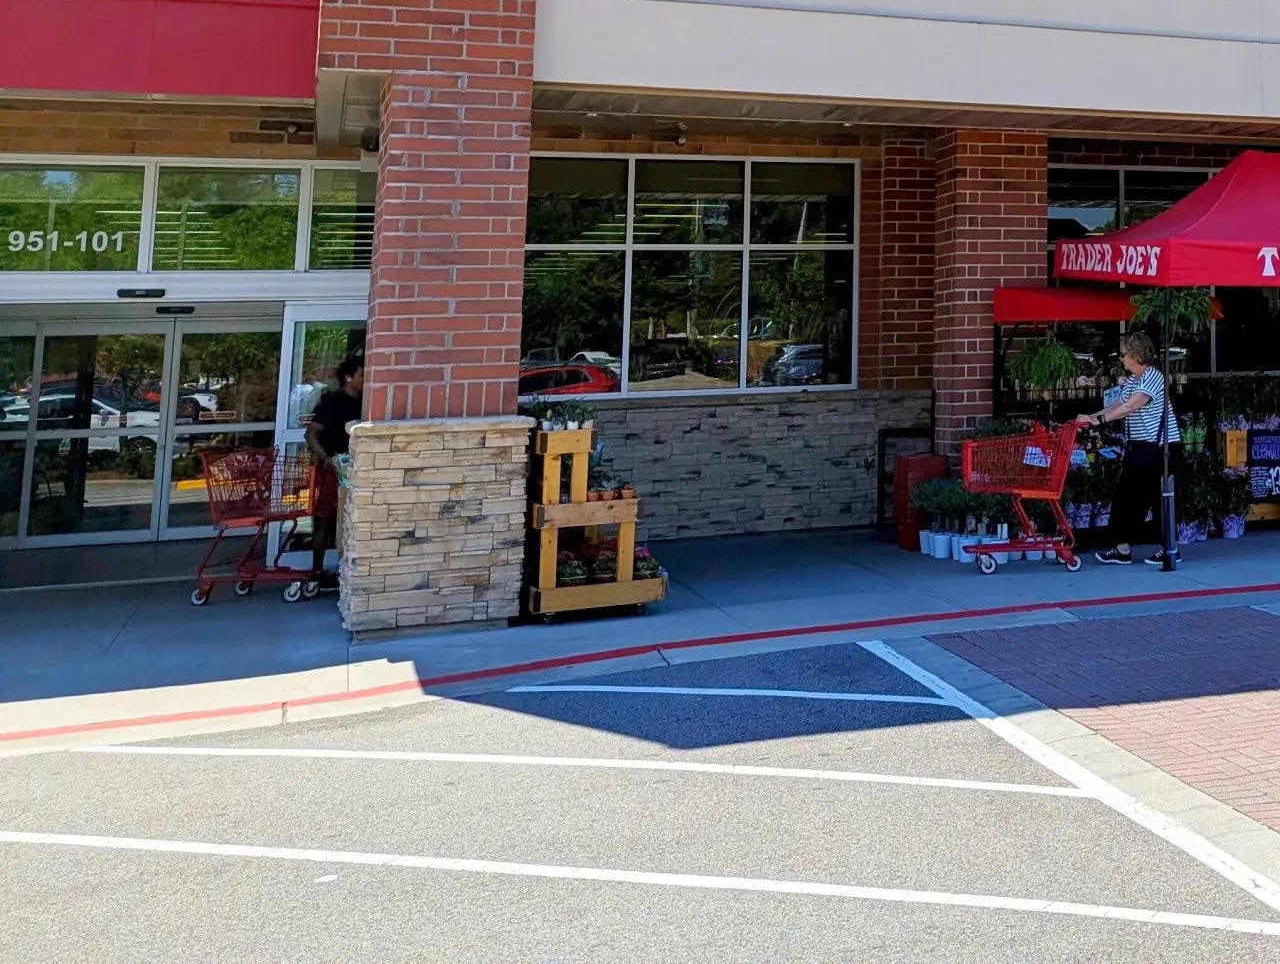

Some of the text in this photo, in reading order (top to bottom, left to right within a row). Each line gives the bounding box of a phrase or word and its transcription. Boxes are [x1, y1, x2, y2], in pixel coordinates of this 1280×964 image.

[8, 230, 124, 252] 951-101
[1061, 243, 1161, 276] TRADER JOE'S
